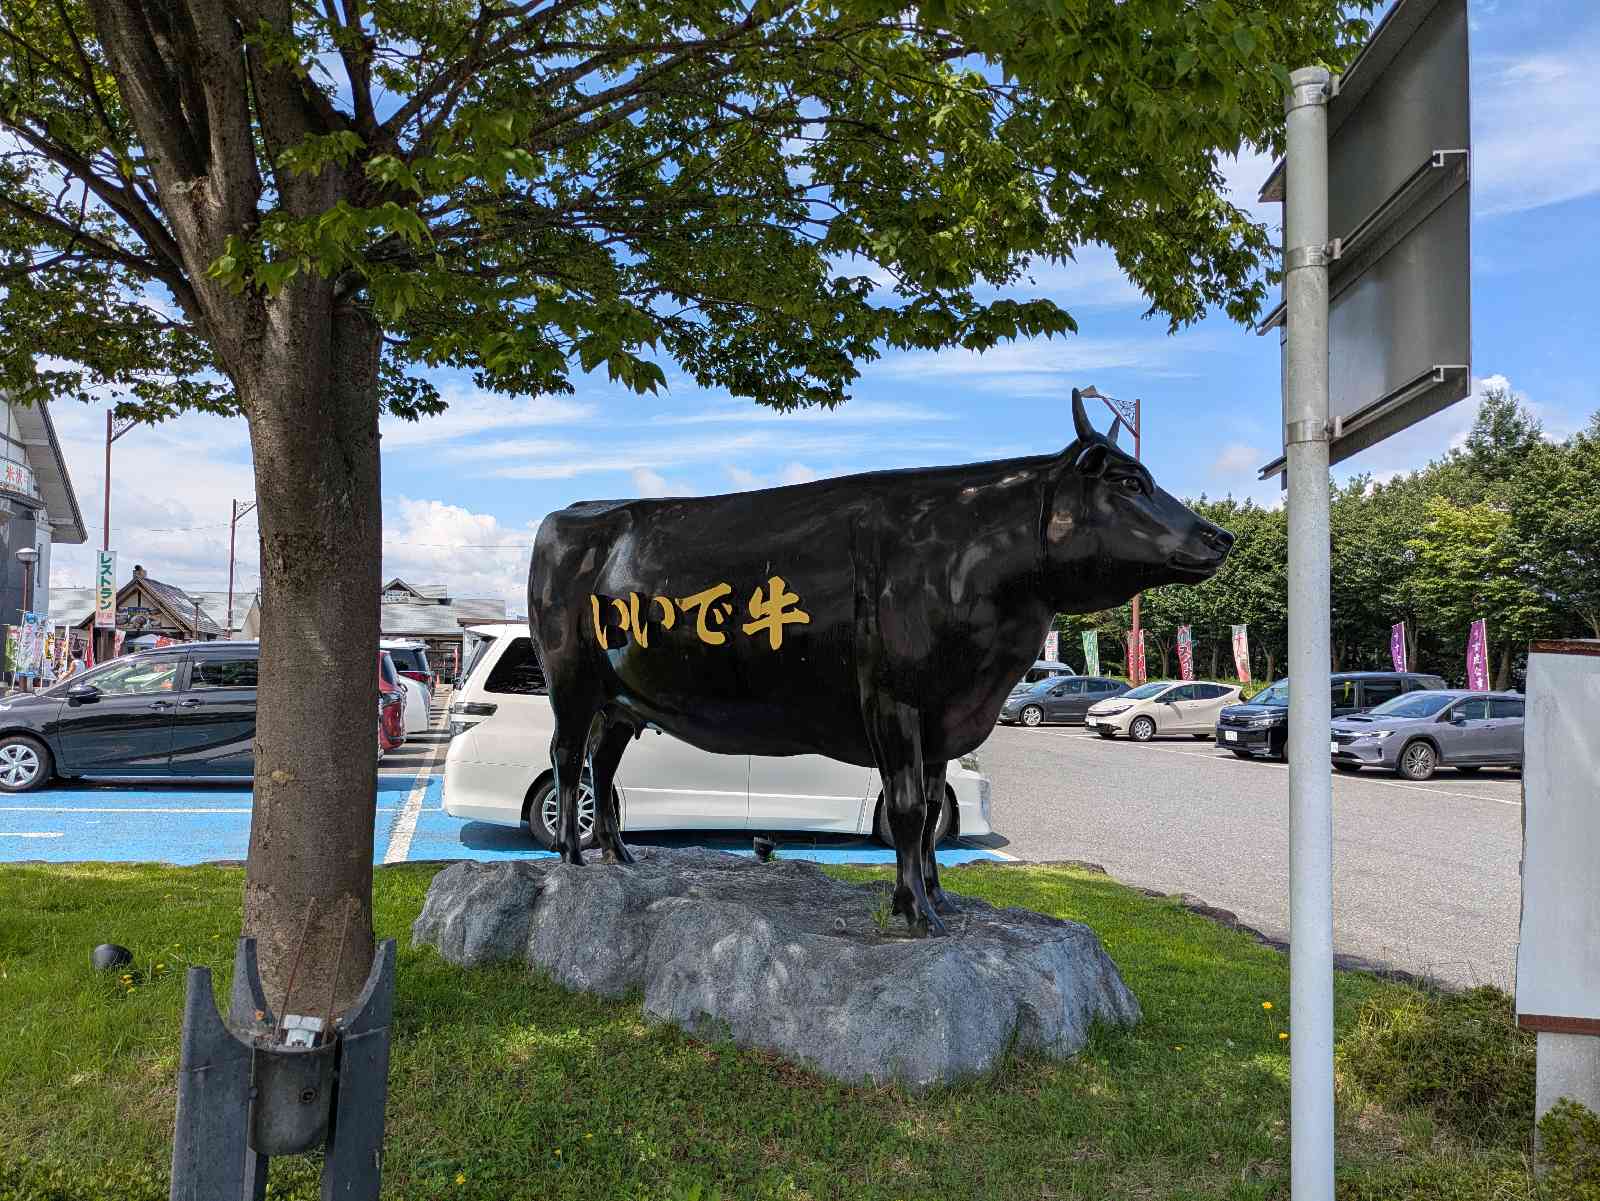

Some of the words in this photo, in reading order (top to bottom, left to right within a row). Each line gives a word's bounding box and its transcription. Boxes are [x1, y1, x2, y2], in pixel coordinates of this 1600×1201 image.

[100, 552, 113, 610] レストラン
[590, 575, 810, 651] いいで牛
